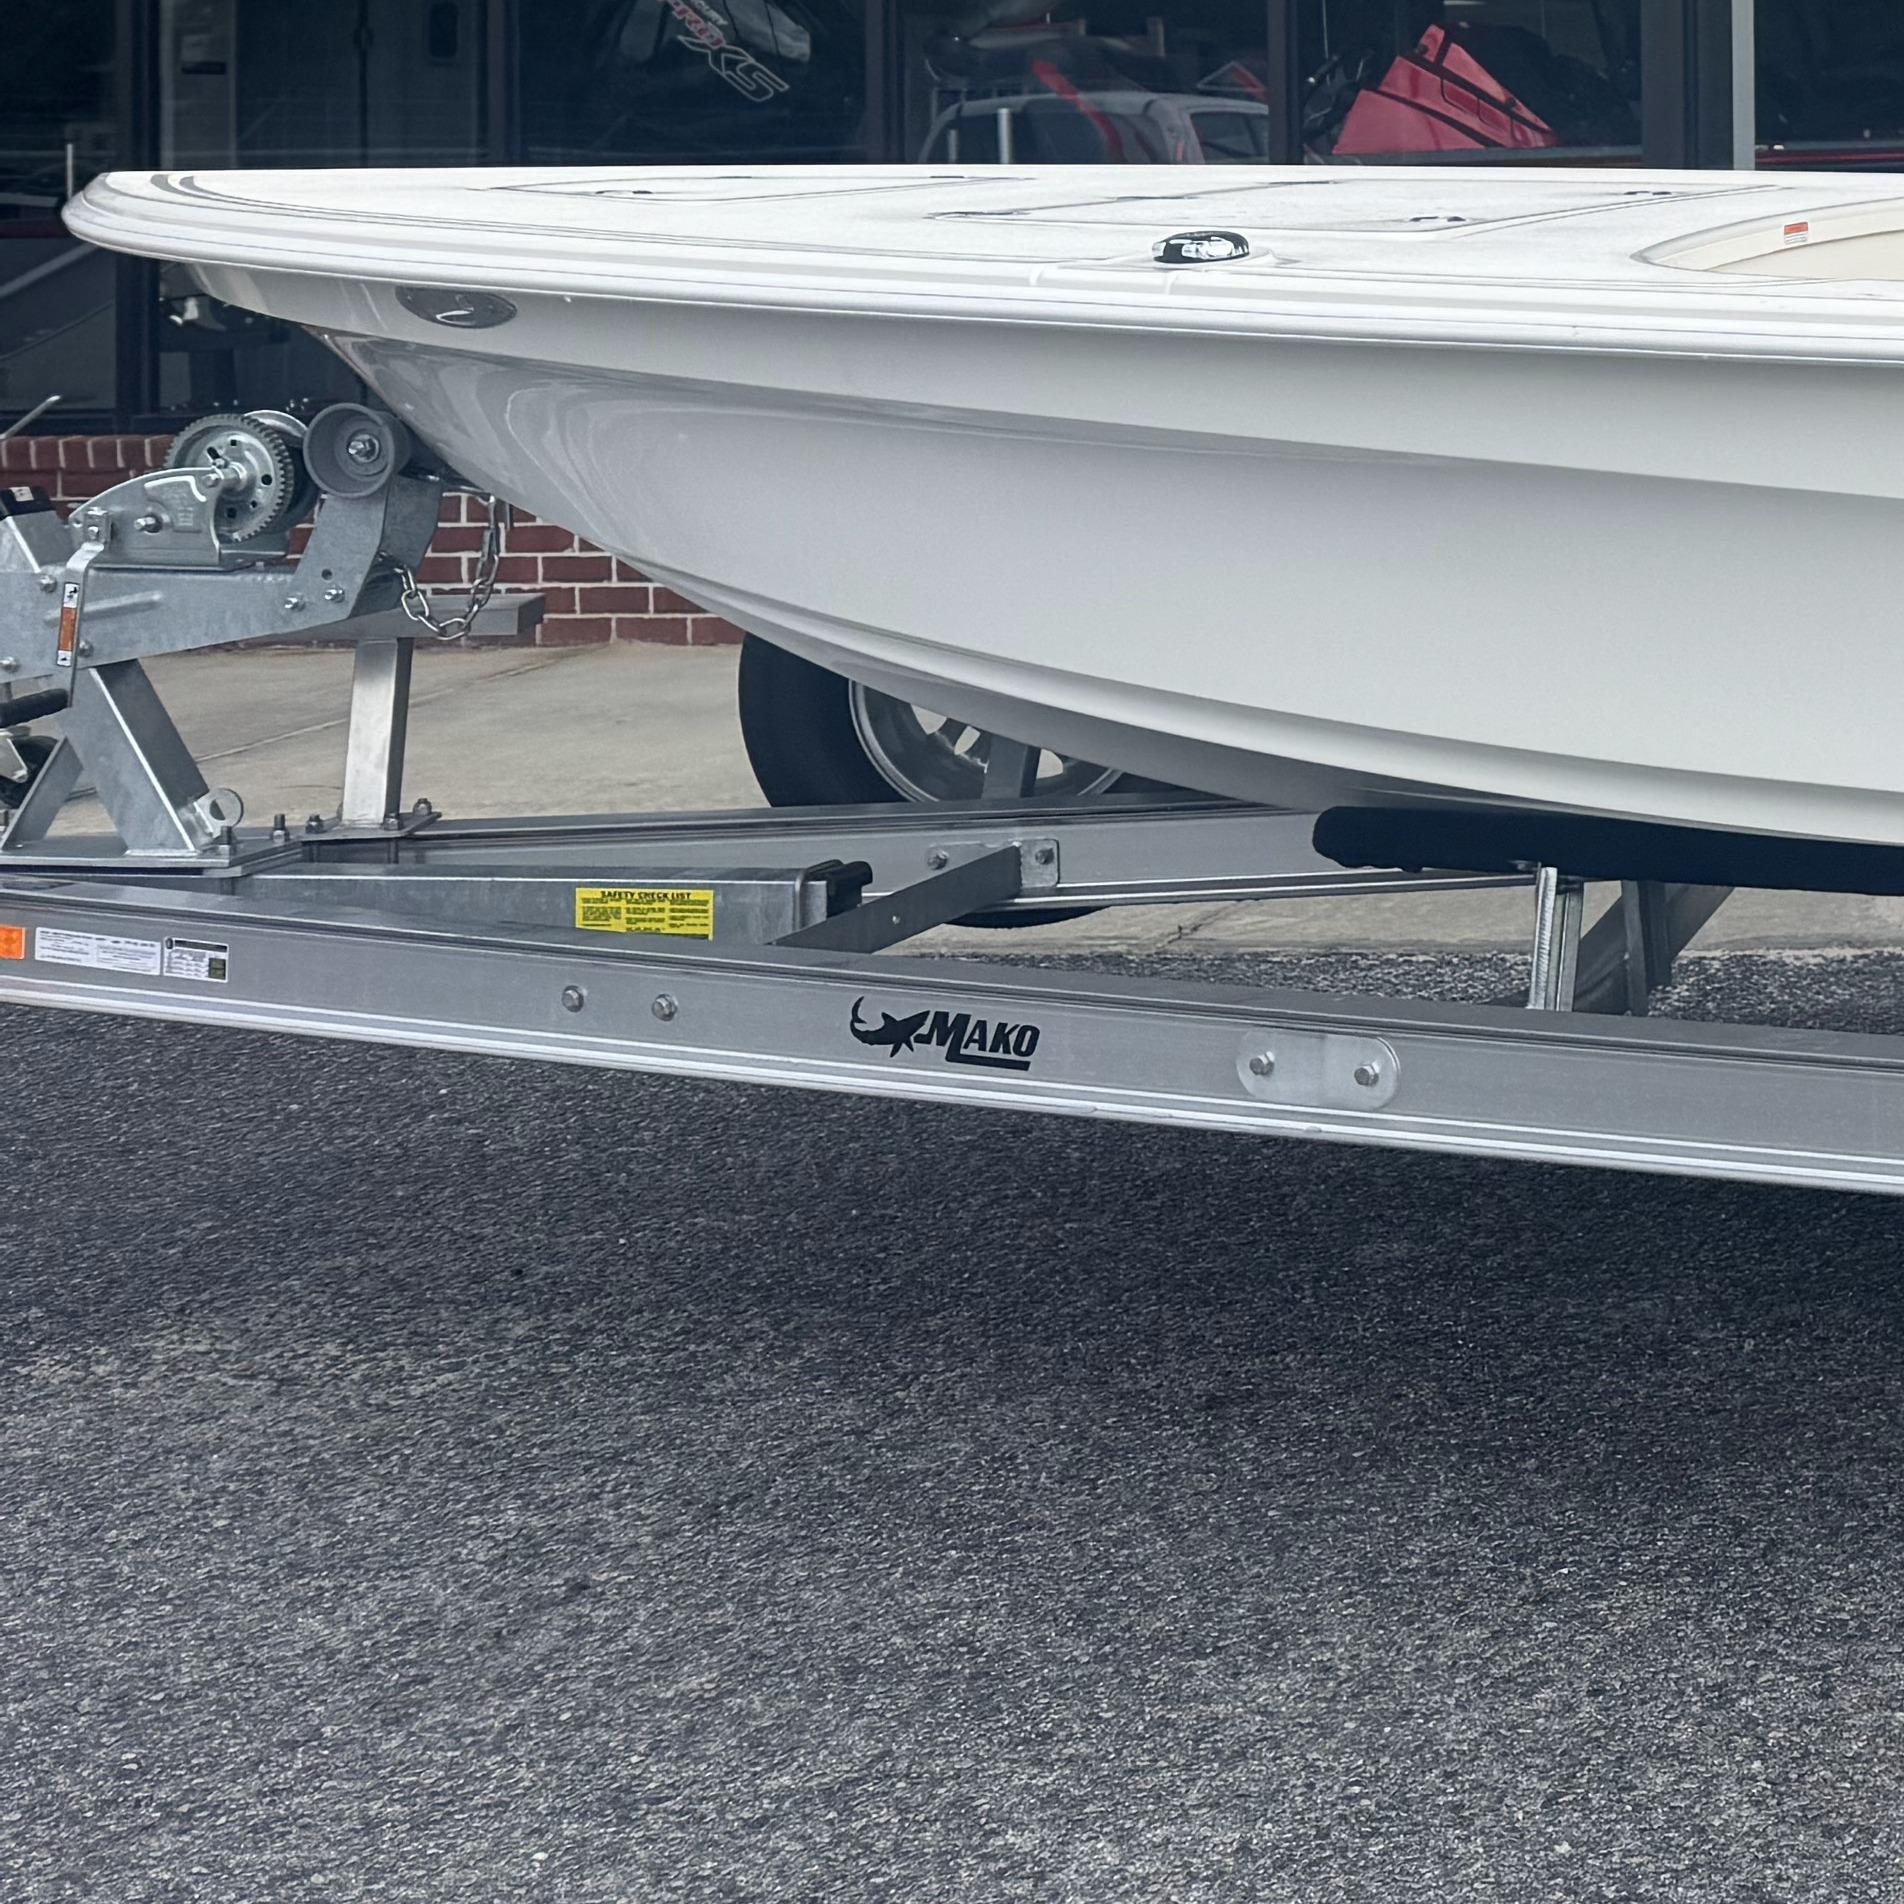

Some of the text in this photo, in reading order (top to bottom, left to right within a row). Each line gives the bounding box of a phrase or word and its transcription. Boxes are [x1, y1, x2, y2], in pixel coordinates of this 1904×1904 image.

[600, 890, 693, 900] SAFETY CHECK LIST
[913, 1010, 1041, 1072] MAKO
